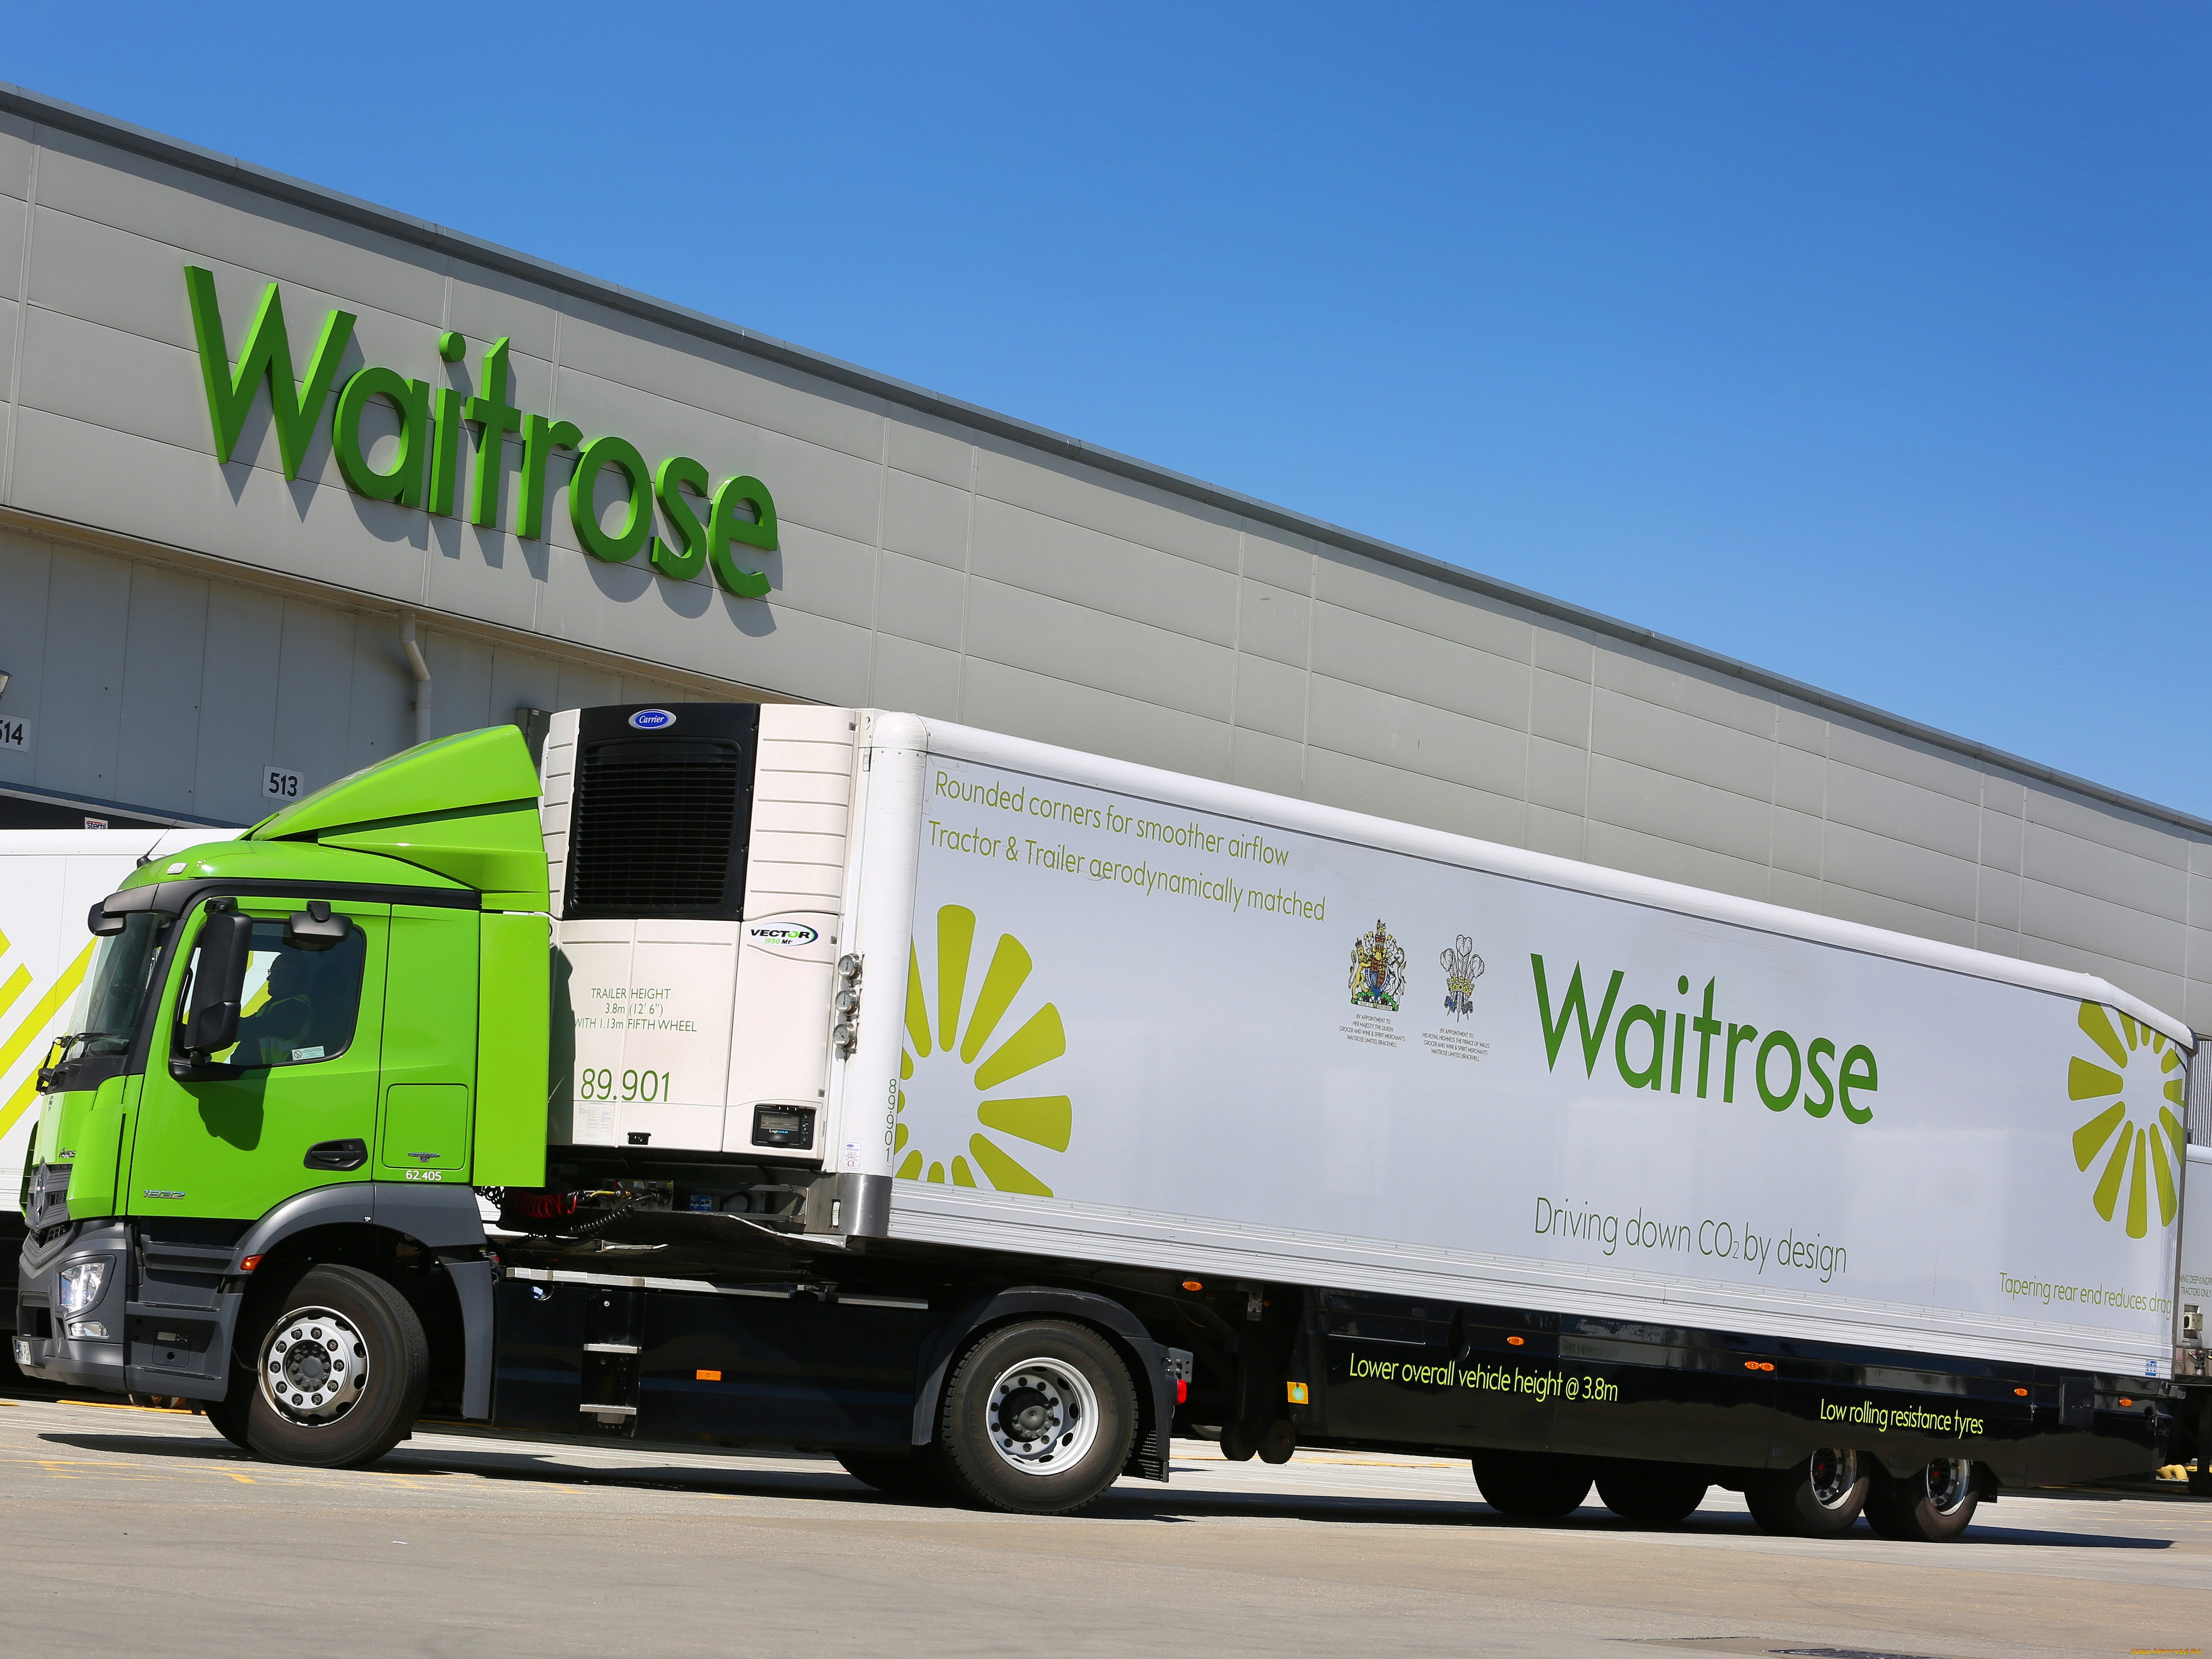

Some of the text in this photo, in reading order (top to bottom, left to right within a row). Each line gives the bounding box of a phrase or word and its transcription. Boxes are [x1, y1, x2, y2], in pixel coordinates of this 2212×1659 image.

[184, 265, 778, 598] Waitrose
[639, 715, 665, 724] Carrier
[269, 772, 298, 797] 513
[935, 771, 1290, 867] Rounded corners for smoother airflow
[928, 820, 1326, 921] Tractor & Trailer aerodynamically matched
[751, 929, 810, 939] VECTOR
[591, 988, 671, 999] TRAILER HEIGHT
[605, 1003, 625, 1014] 3.8m
[629, 1003, 646, 1017] (12'
[1361, 1015, 1385, 1023] APPOINTMENT
[575, 1017, 697, 1032] WITH 1.13m FIFTH WHEEL
[1445, 1029, 1468, 1037] APPOINTMENT
[1385, 1033, 1405, 1041] MERCHANTS
[1530, 953, 1878, 1125] Waitrose
[1468, 1047, 1488, 1055] MERCHANTS
[581, 1068, 670, 1102] 89.901
[885, 1079, 897, 1162] 89.901
[406, 1170, 442, 1181] 62.405
[1535, 1197, 1618, 1256] Driving
[1626, 1206, 1691, 1252] down
[1744, 1221, 1771, 1274] by
[1777, 1228, 1846, 1283] design
[1999, 1272, 2172, 1320] Tapering rear end reduces drag
[2181, 1286, 2211, 1297] TRACTORS ONLY
[1350, 1353, 1618, 1402] Lower overall vehicle height @ 3.8m
[1820, 1398, 1984, 1439] Low rolling resistance tyres
